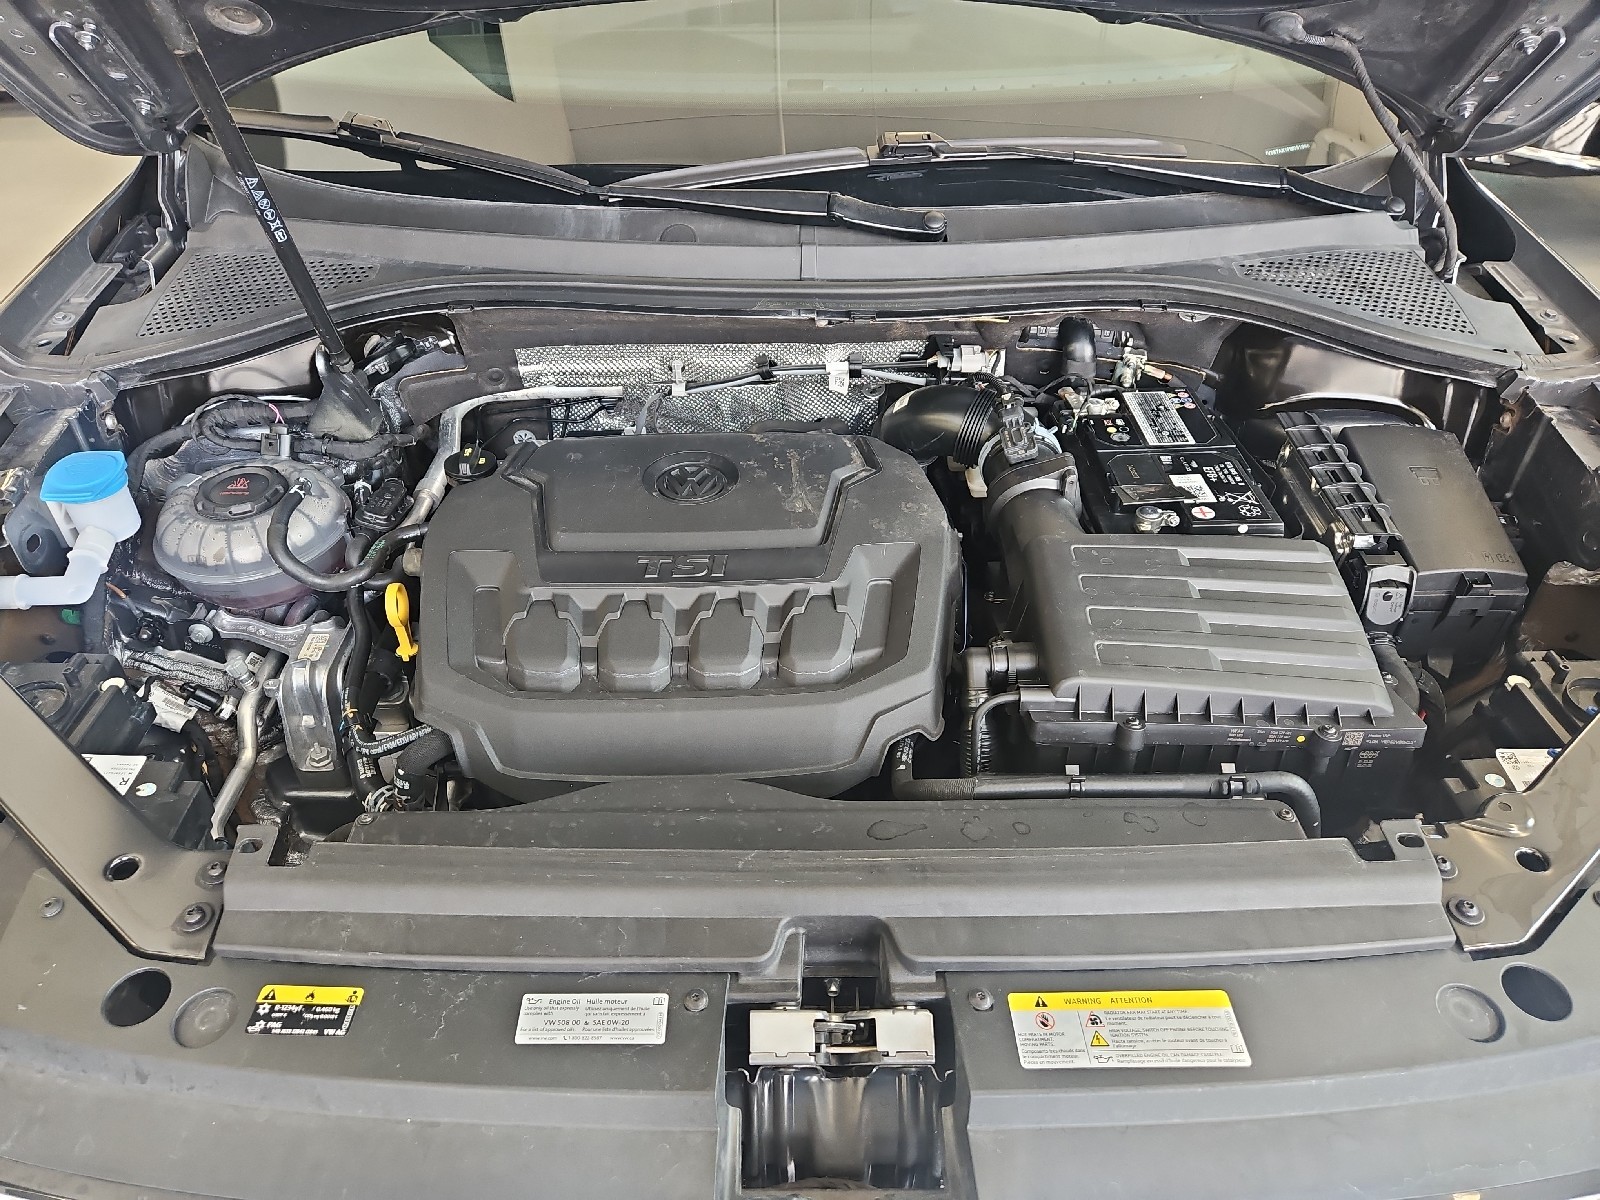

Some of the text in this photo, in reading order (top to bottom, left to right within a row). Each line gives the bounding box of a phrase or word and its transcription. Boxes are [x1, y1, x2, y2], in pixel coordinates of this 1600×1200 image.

[637, 554, 729, 578] TSI
[119, 777, 131, 786] R
[548, 998, 571, 1006] Engine
[1063, 996, 1153, 1005] WARNING ATTENTION
[266, 1021, 283, 1029] PAG
